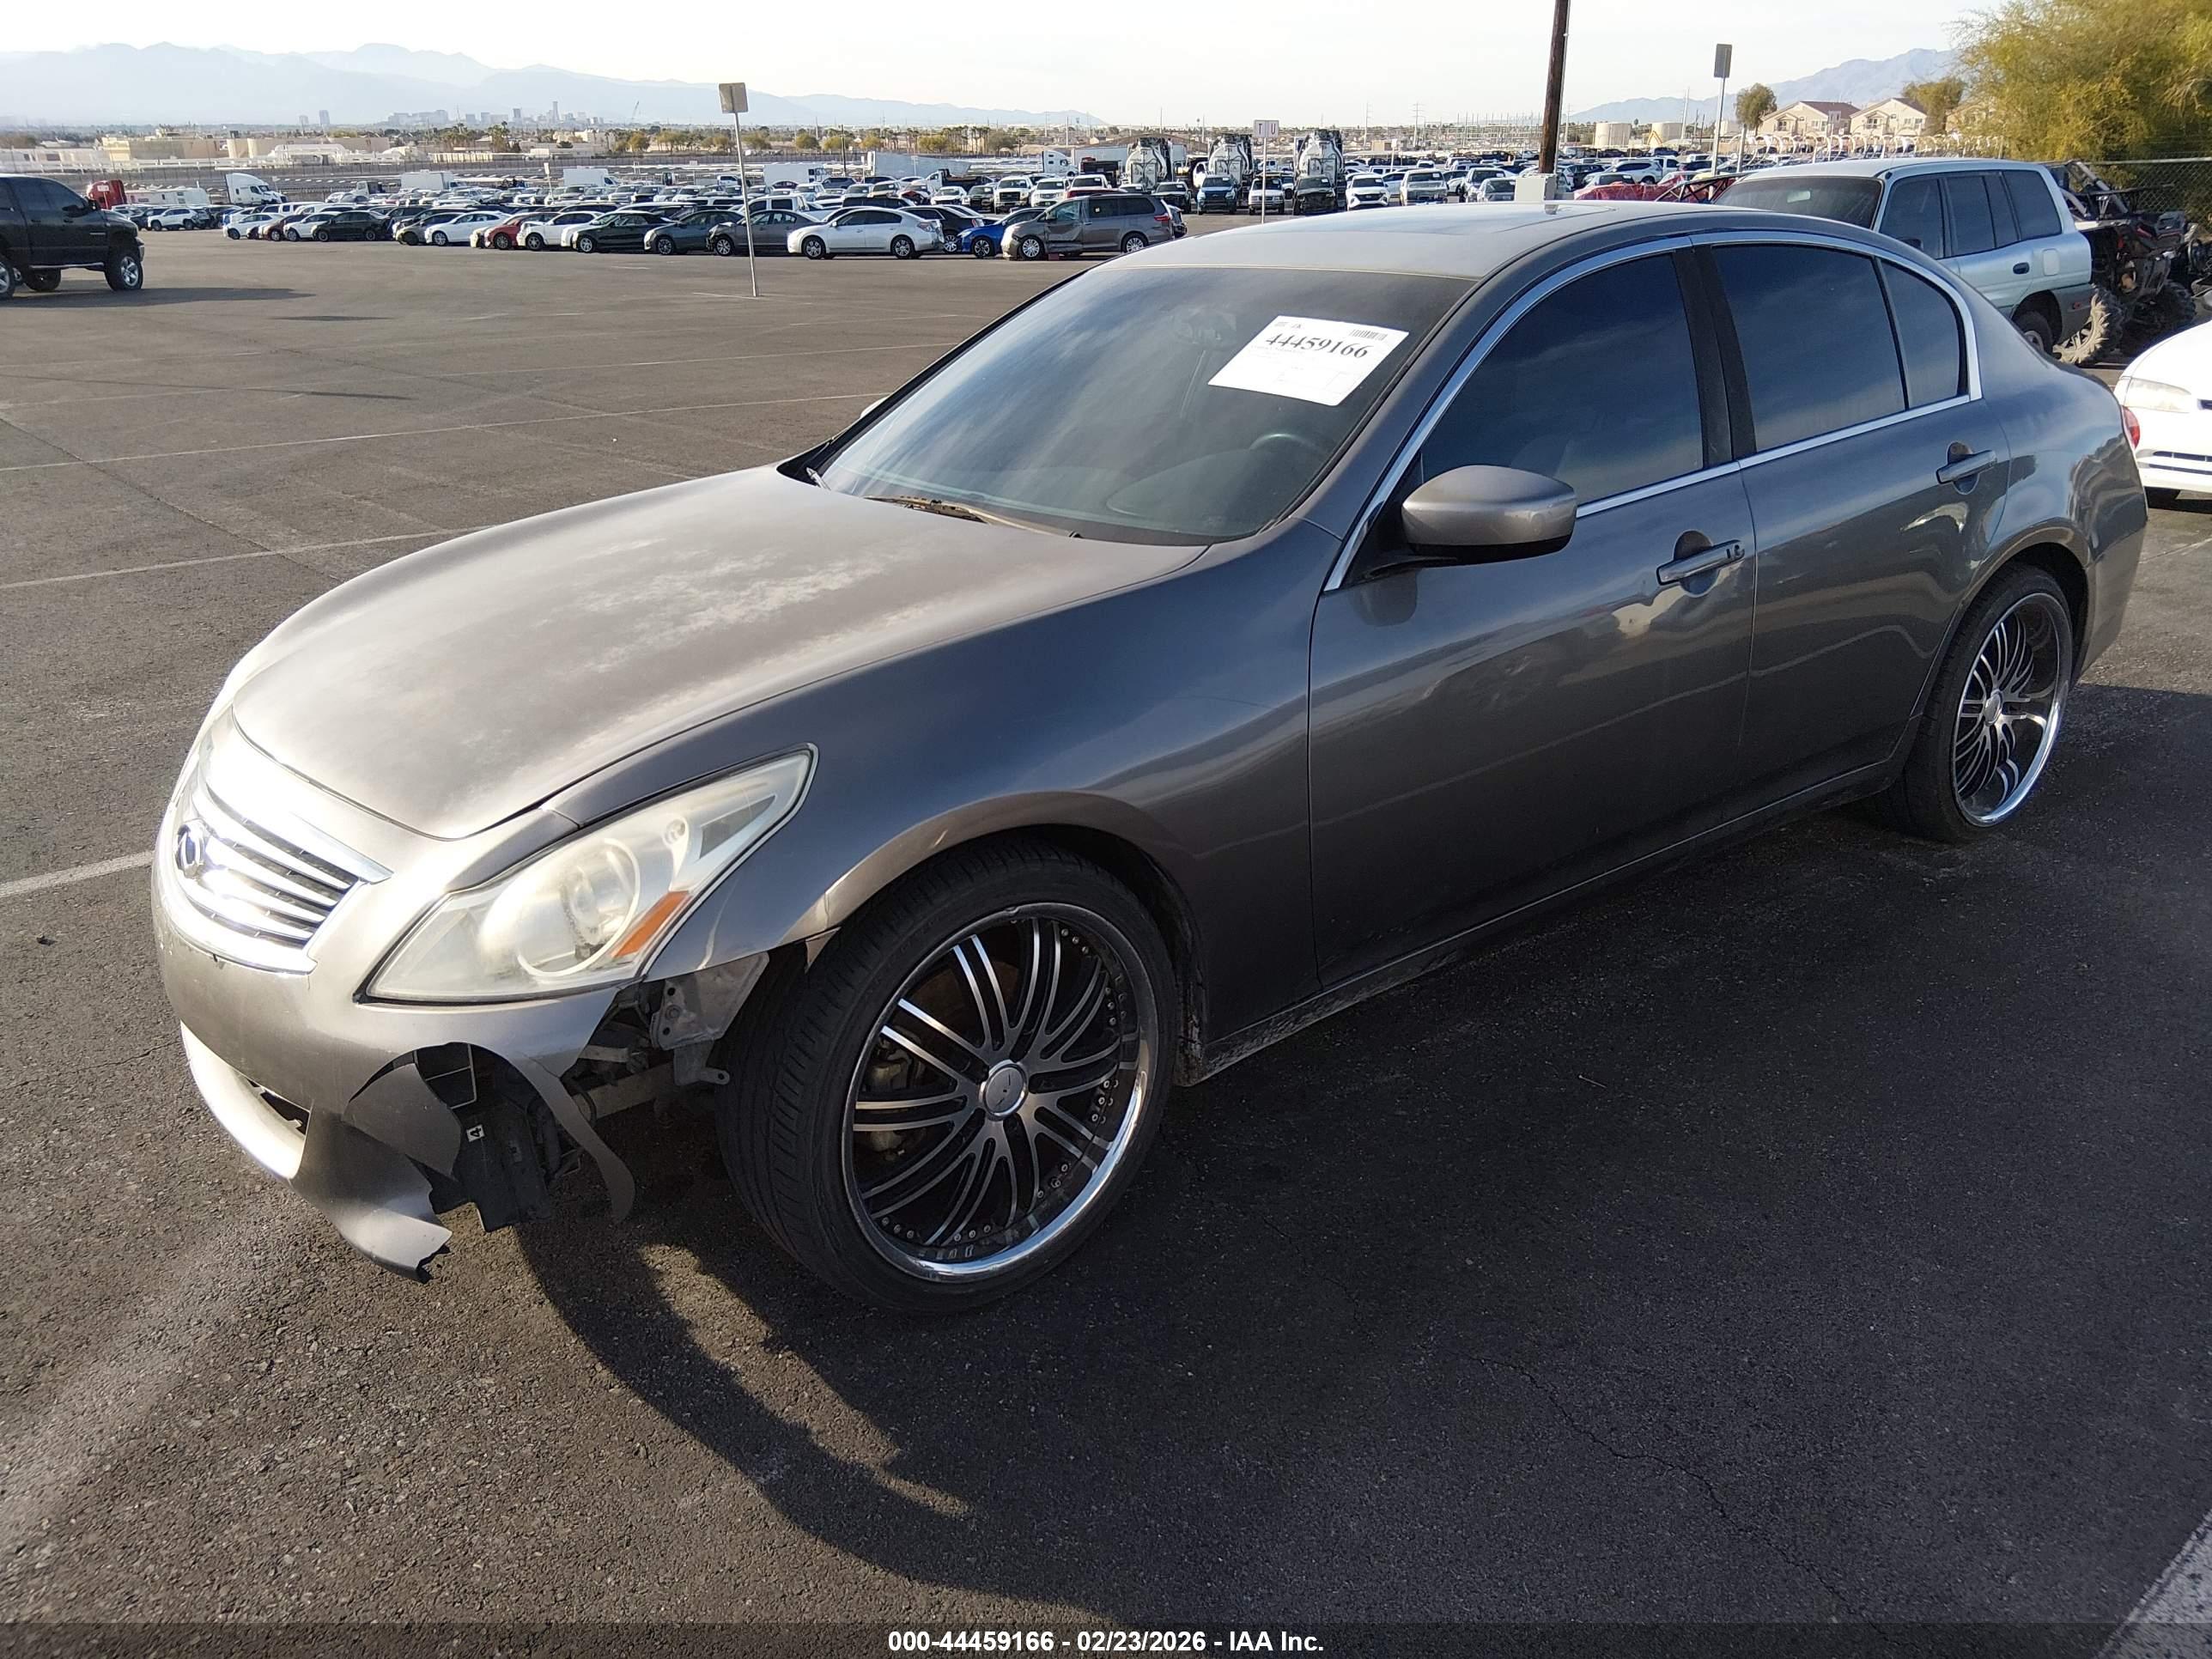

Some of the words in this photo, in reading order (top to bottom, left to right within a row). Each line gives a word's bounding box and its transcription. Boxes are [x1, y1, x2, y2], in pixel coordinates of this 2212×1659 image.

[1258, 123, 1263, 135] T
[1271, 123, 1276, 135] U
[1265, 332, 1374, 358] 44459166
